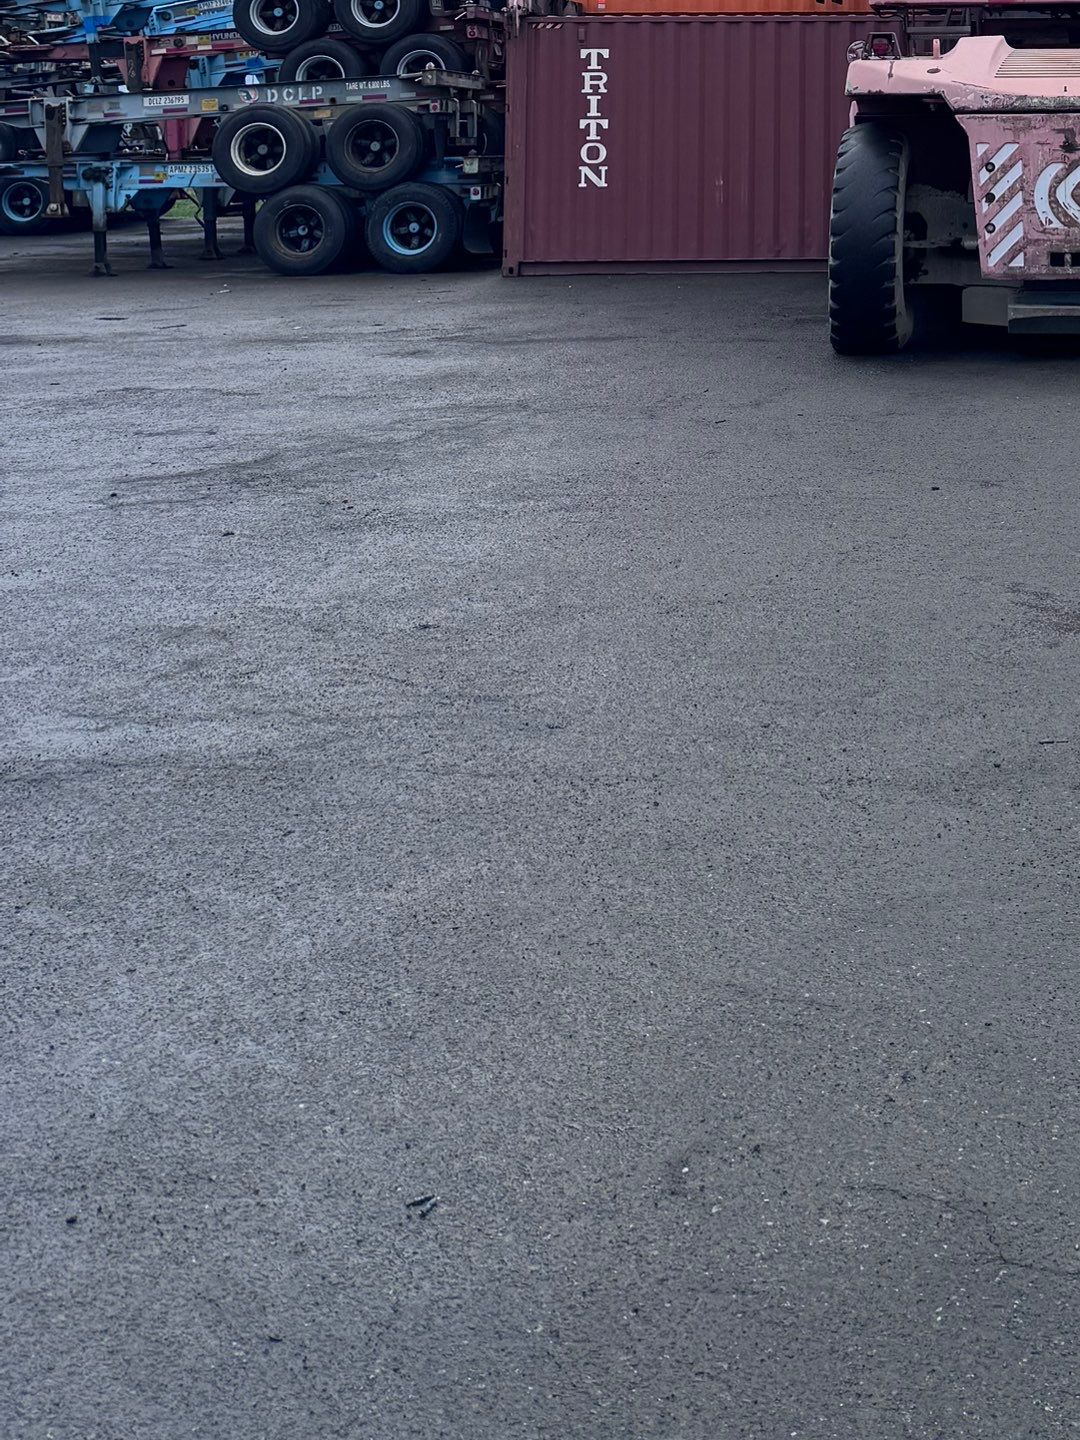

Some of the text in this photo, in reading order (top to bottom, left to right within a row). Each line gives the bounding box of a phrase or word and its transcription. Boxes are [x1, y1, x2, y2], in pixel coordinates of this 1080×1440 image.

[210, 31, 241, 40] HYUND
[266, 85, 323, 103] DCLP
[578, 48, 609, 187] TRITON
